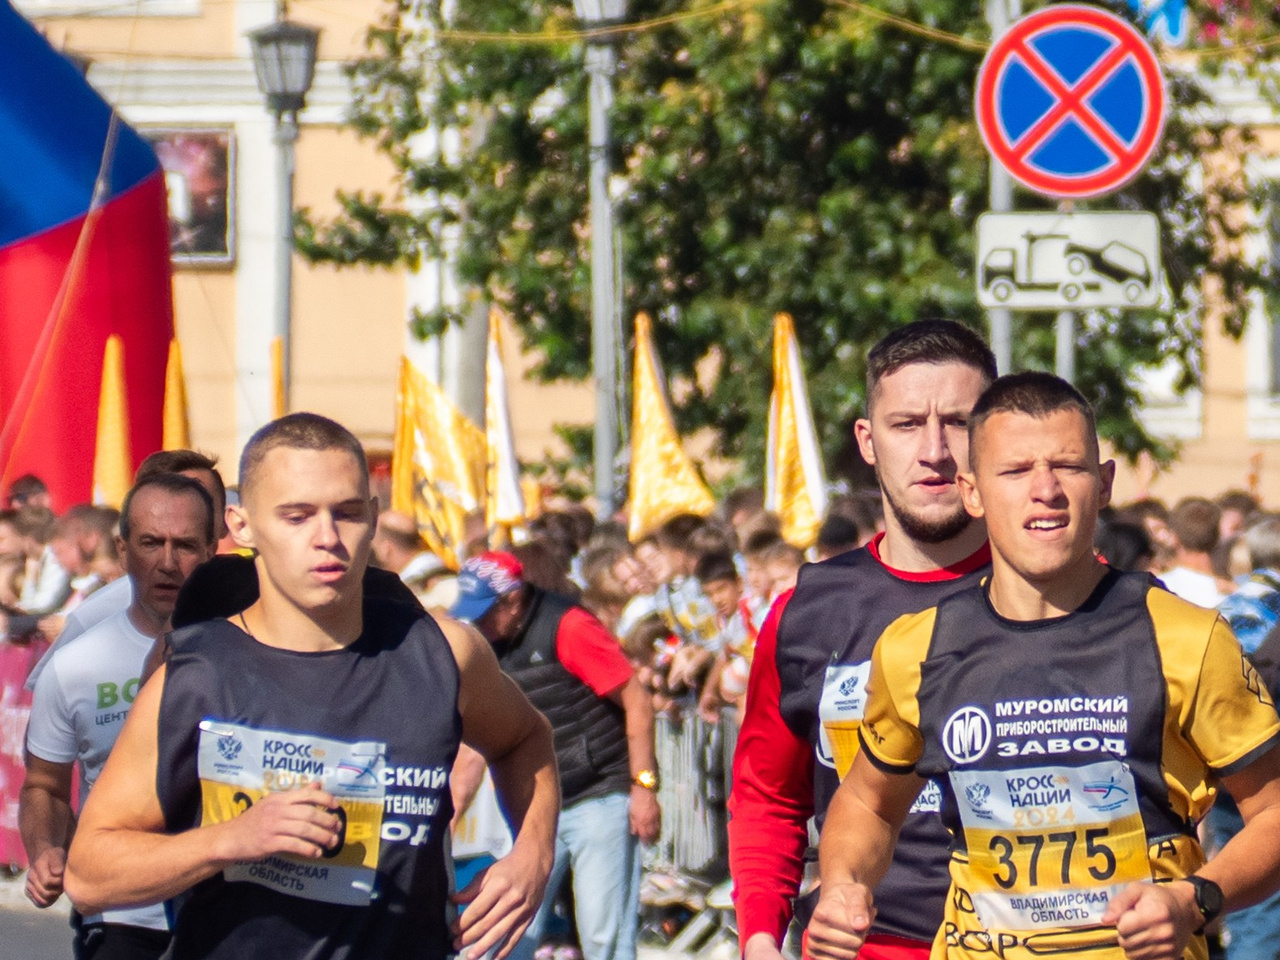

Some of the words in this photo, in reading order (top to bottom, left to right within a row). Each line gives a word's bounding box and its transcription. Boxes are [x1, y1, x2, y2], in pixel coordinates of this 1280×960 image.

[995, 696, 1129, 717] МУРОМСКИЙ
[996, 717, 1128, 737] ПРИБОРОСТРОИТЕЛЬНЫЙ
[263, 739, 312, 758] КРОСС
[996, 737, 1127, 757] ЗАВОД
[262, 756, 325, 775] НАЦИИ
[1006, 774, 1055, 793] КРОСС
[1010, 788, 1071, 807] НАЦИИ
[1013, 806, 1076, 827] 2024
[989, 827, 1117, 890] 3775
[248, 866, 305, 891] ОБЛАСТЬ
[1010, 891, 1109, 910] ВЛАДИМИРСКАЯ
[1031, 908, 1089, 923] ОБЛАСТЬ
